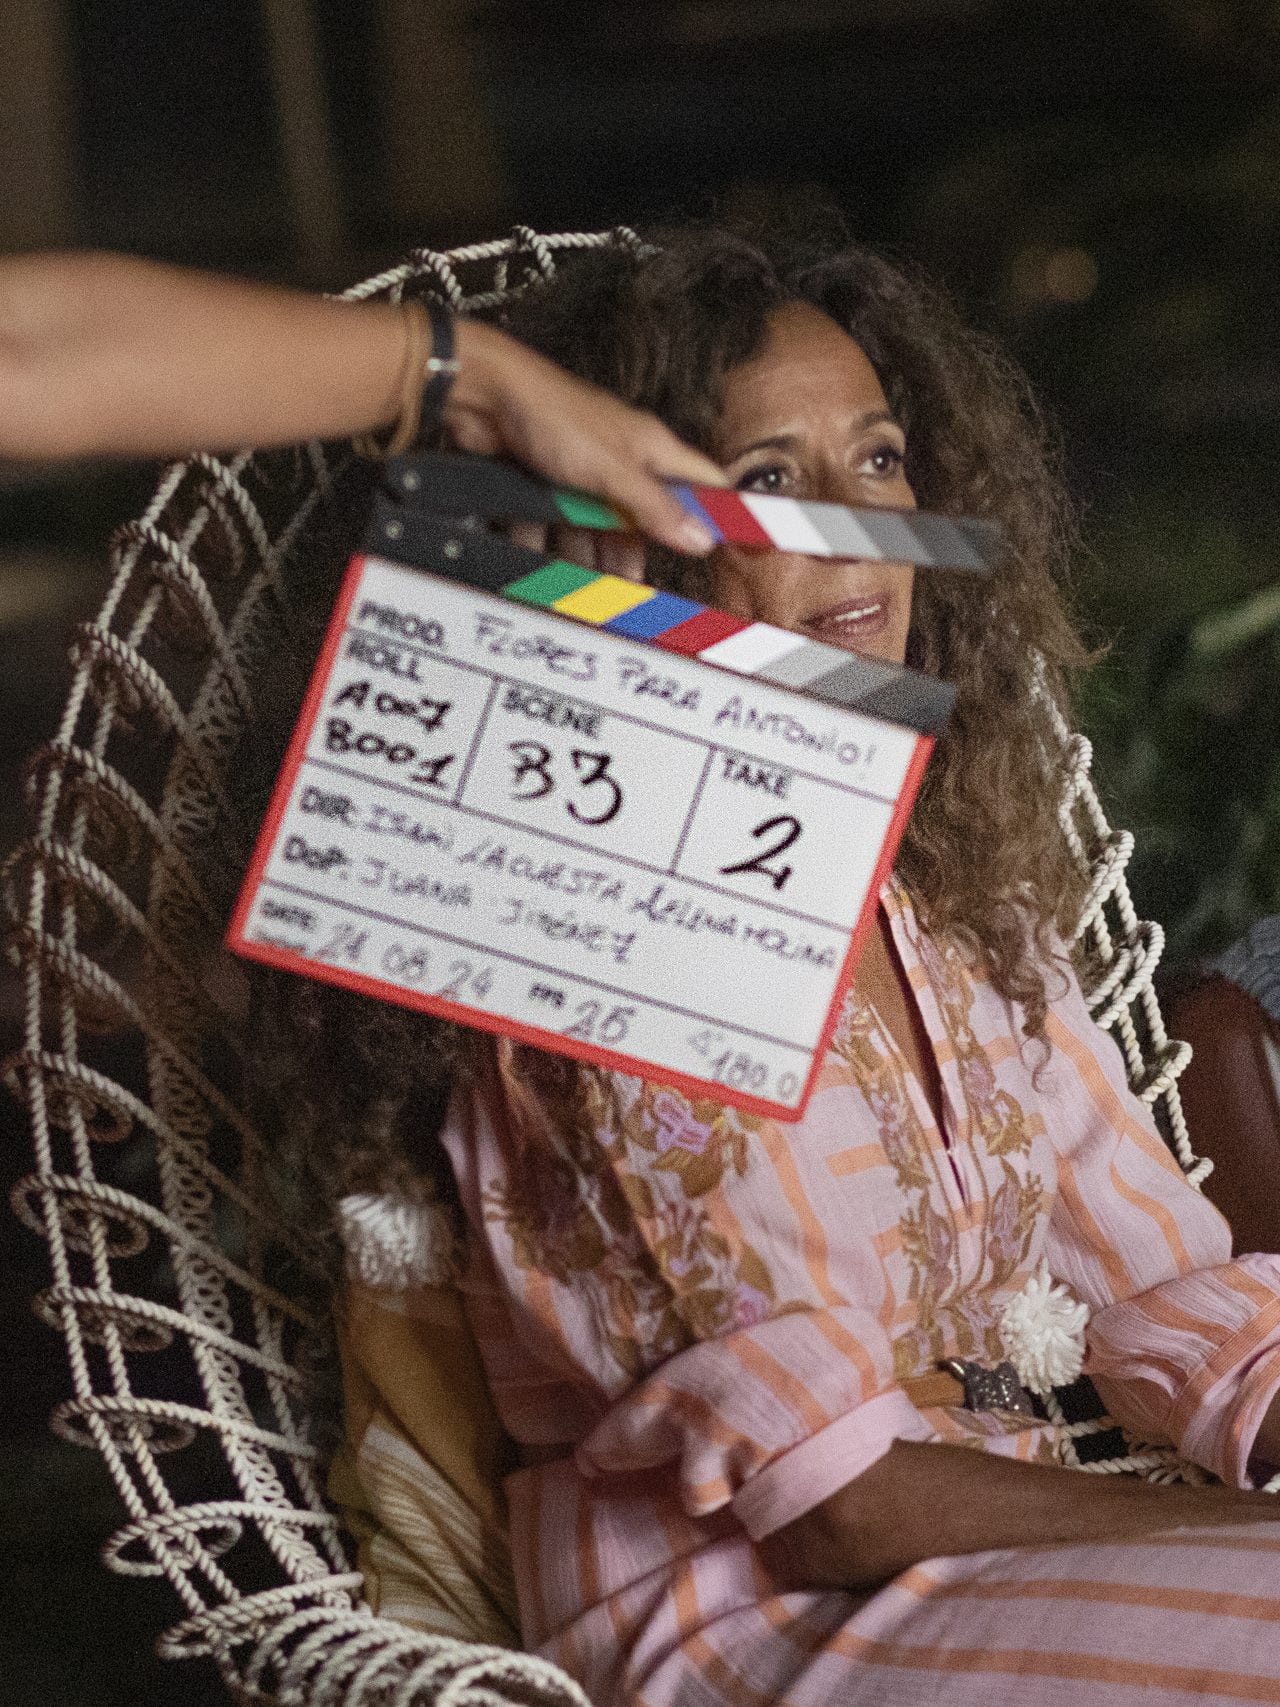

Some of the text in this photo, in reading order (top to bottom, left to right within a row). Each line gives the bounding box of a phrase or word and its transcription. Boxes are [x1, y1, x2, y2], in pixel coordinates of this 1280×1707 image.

[348, 633, 422, 683] ROLL
[475, 610, 598, 682] FLORES
[617, 656, 701, 712] PARA
[503, 687, 602, 739] SCENE
[722, 755, 795, 800] TAKE
[720, 814, 804, 892] 2
